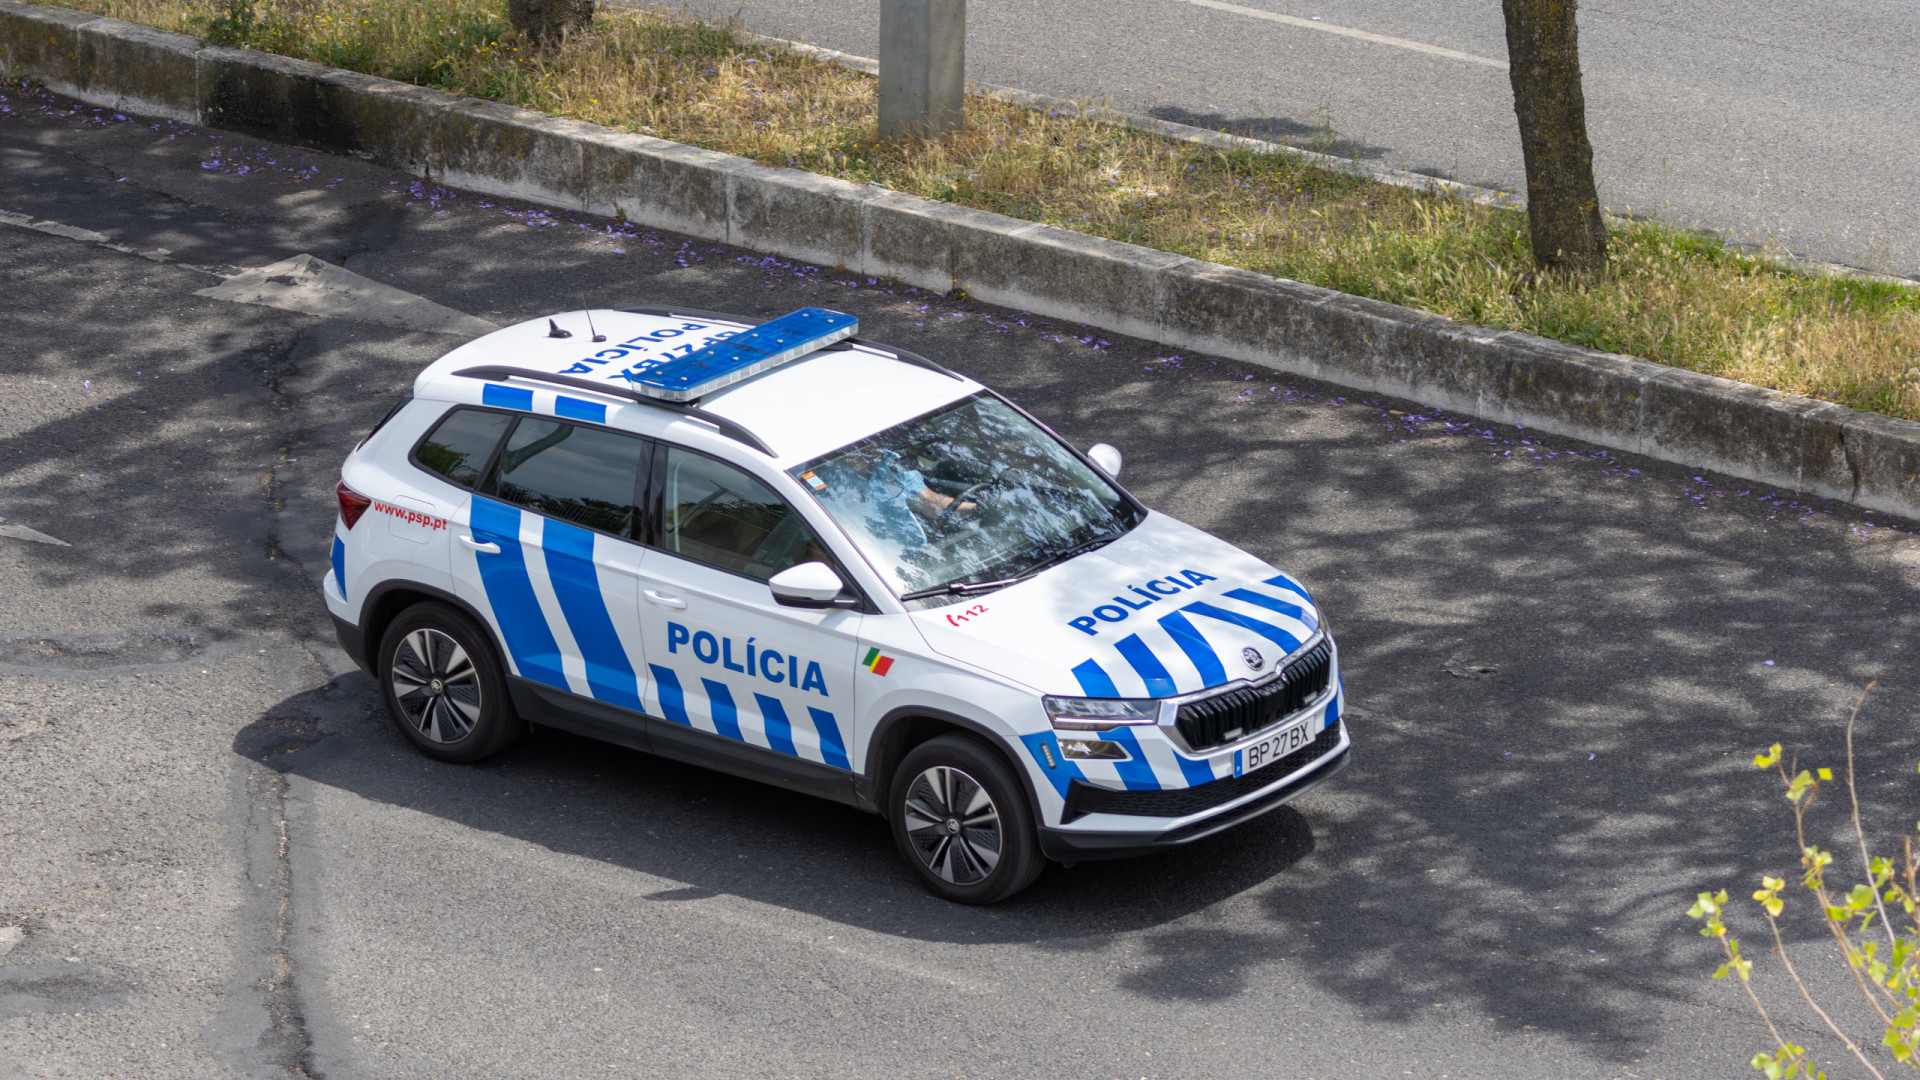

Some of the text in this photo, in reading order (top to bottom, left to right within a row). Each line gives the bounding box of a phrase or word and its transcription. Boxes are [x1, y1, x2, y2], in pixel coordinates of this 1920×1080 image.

[557, 322, 709, 374] POLÍCIA
[374, 501, 448, 531] www.psp.pt
[957, 604, 990, 622] 112
[1067, 569, 1218, 636] POLÍCIA
[667, 620, 829, 697] POLÍCIA
